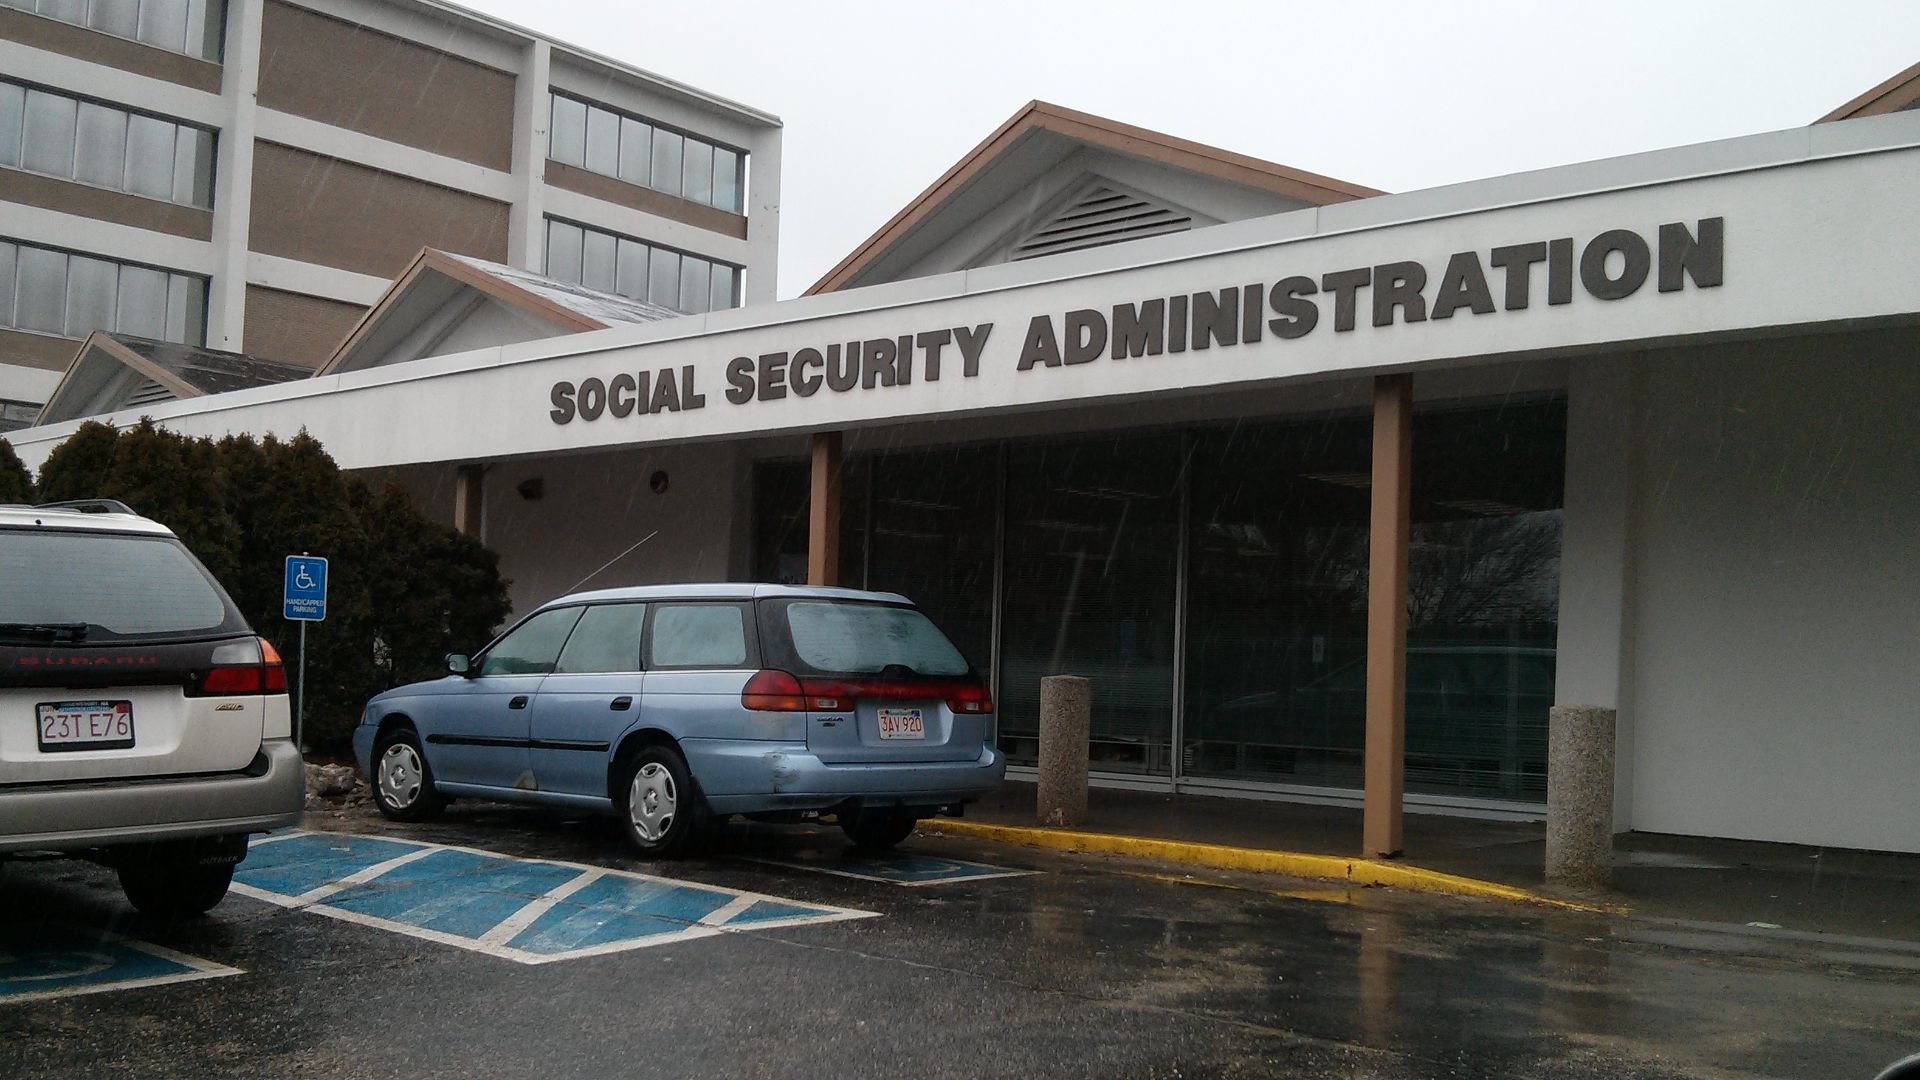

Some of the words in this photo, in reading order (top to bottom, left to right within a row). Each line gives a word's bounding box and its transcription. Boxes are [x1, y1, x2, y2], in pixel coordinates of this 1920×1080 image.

[550, 364, 705, 425] SOCIAL
[726, 323, 993, 405] SECURITY
[1017, 216, 1724, 371] ADMINISTRATION
[18, 656, 159, 665] SUBARU
[43, 714, 82, 738] 23T
[89, 713, 129, 737] E76
[902, 716, 922, 732] 920
